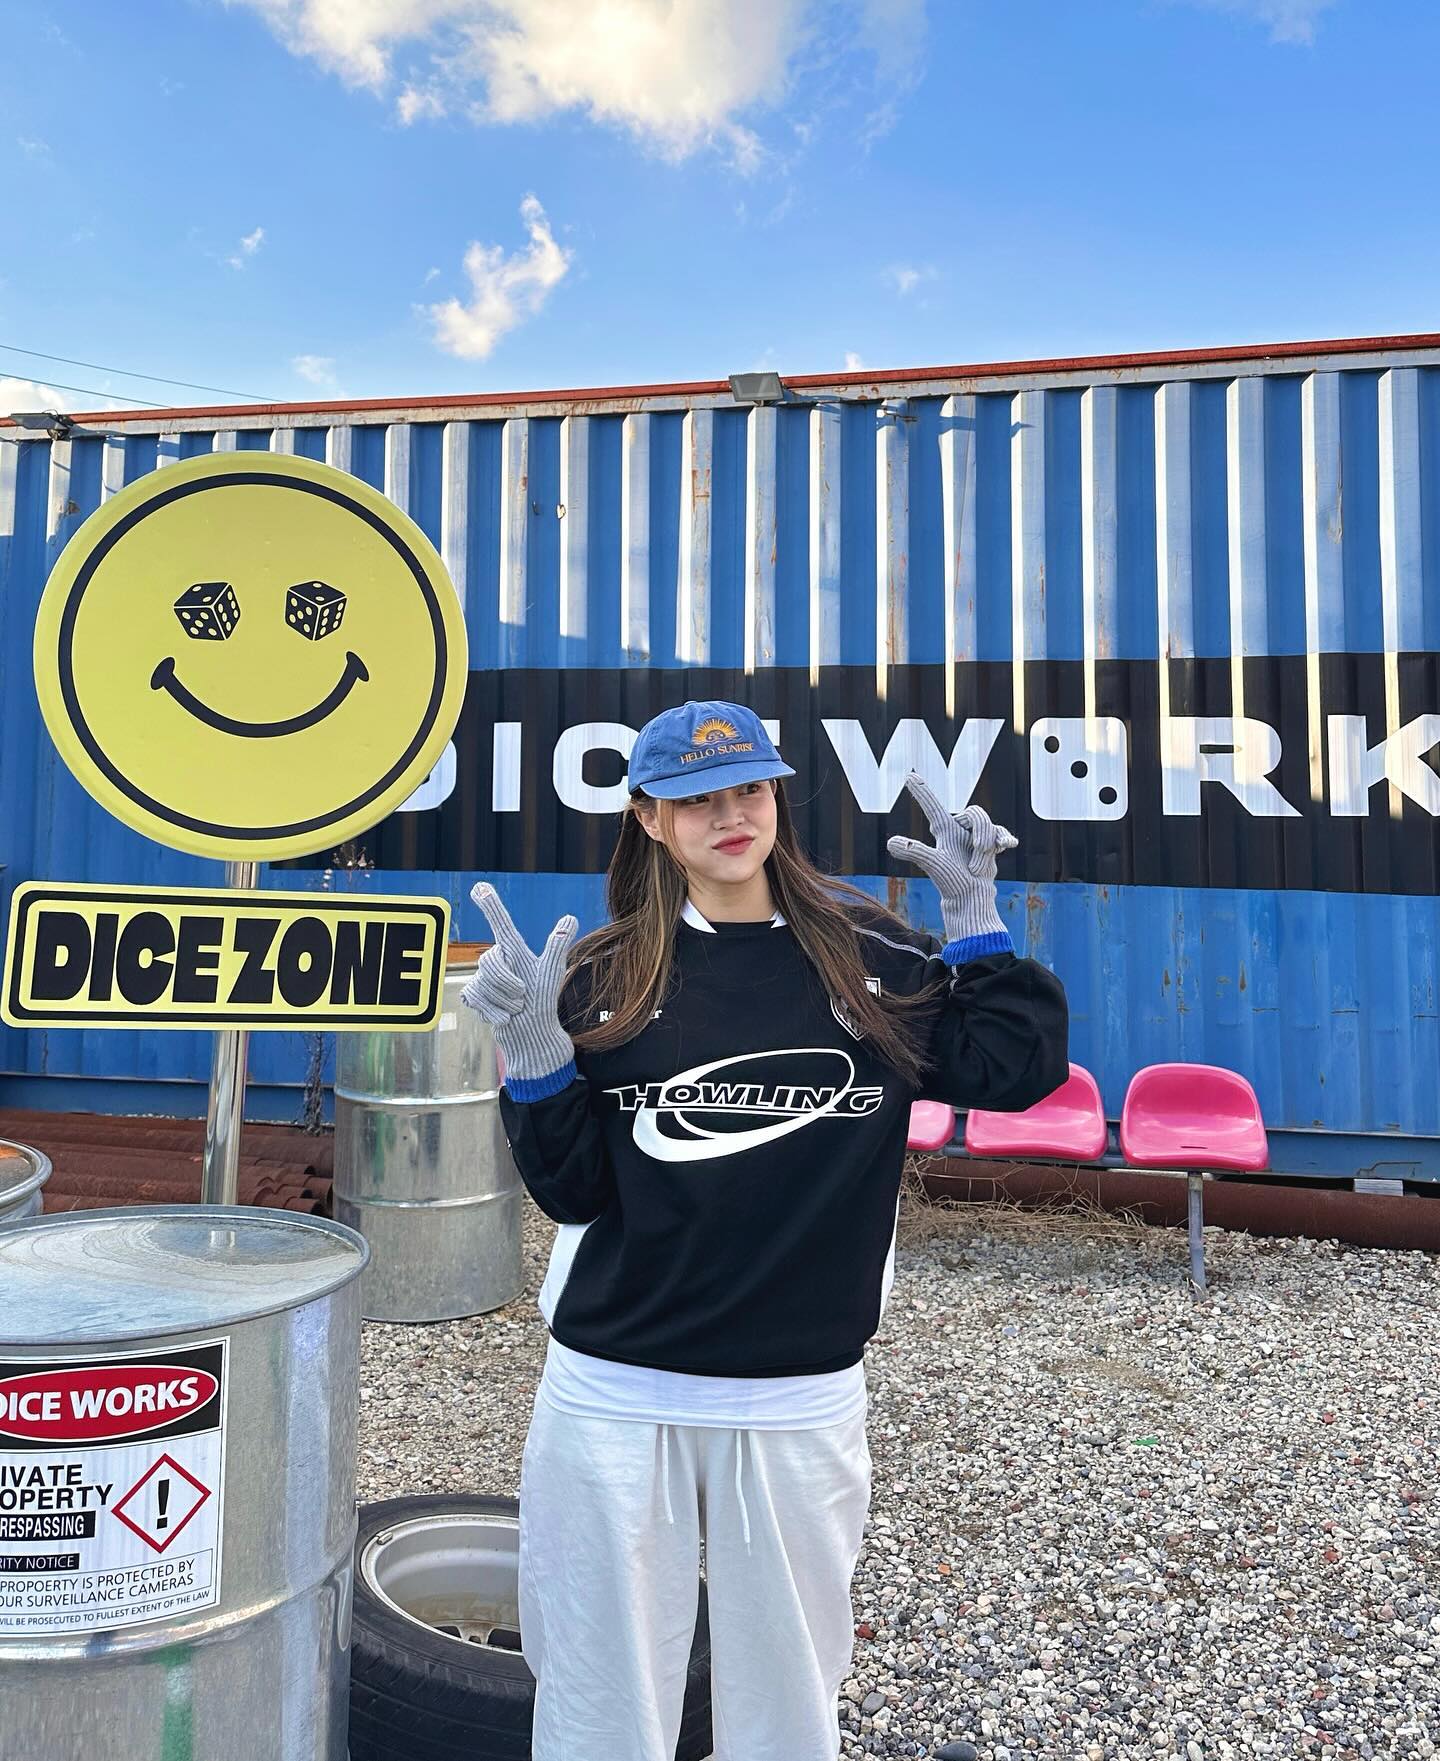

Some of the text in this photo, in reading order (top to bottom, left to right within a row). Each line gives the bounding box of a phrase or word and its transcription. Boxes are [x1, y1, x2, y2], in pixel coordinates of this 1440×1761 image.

[680, 743, 754, 764] HELLO SUNRISE
[30, 911, 427, 1008] DICE ZONE
[602, 1082, 884, 1118] HOWLING
[70, 1376, 199, 1420] WORKS
[1, 1463, 83, 1488] IVATE
[26, 1556, 74, 1569] NOTICE
[82, 1576, 93, 1590] IS
[97, 1564, 174, 1588] PROTECTED
[178, 1558, 195, 1574] BY
[15, 1617, 26, 1626] BE
[27, 1614, 81, 1626] PROSECUTED
[83, 1613, 95, 1622] TO
[96, 1608, 129, 1620] FULLEST
[131, 1602, 161, 1615] EXTENT
[163, 1599, 175, 1609] OF
[176, 1595, 190, 1605] THE
[192, 1590, 210, 1601] LAW
[26, 1587, 125, 1608] SURVEILLANCE
[128, 1572, 194, 1598] CAMERAS
